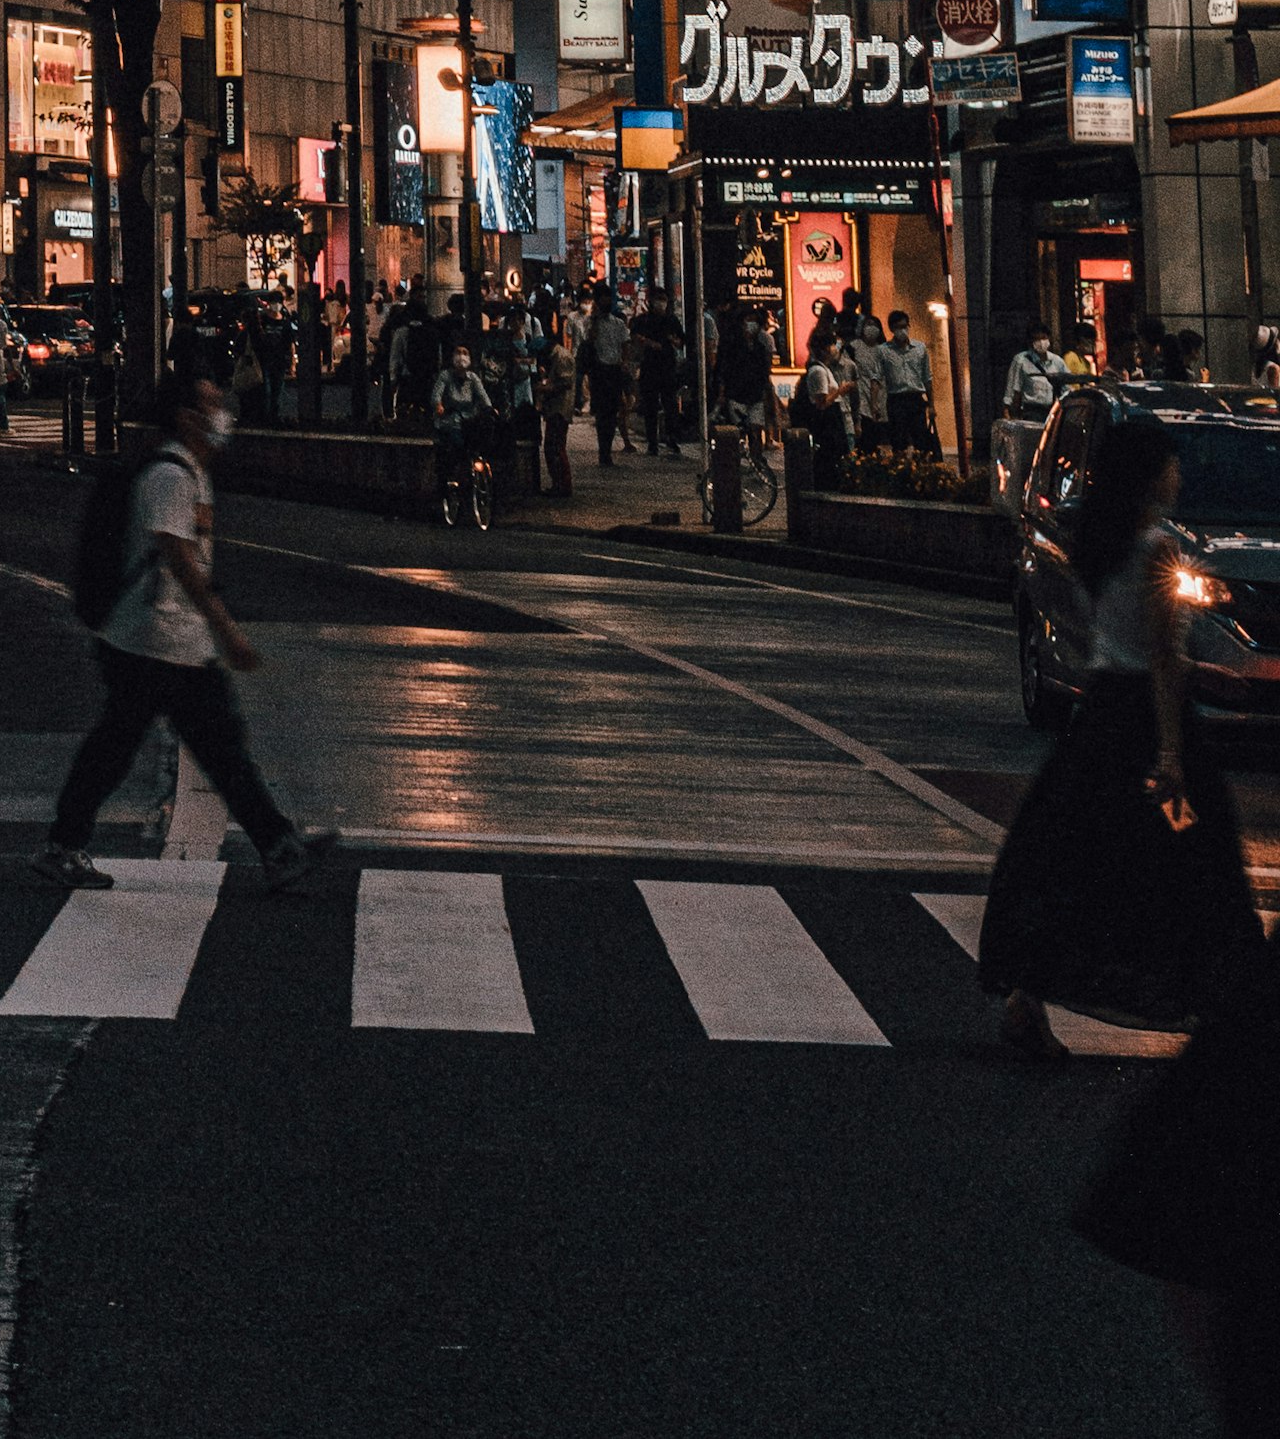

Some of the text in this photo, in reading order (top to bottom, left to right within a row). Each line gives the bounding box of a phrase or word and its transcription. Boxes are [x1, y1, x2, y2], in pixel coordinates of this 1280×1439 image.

[942, 0, 994, 26] 消火栓
[563, 38, 594, 48] BEAUTY
[596, 39, 619, 47] SALON
[1084, 49, 1120, 60] MIZUHO
[1080, 73, 1125, 83] ATMコーナー
[224, 81, 235, 146] CALZEDONIA
[743, 182, 774, 193] 渋谷駅
[749, 267, 774, 280] Cycle
[748, 284, 782, 297] Training
